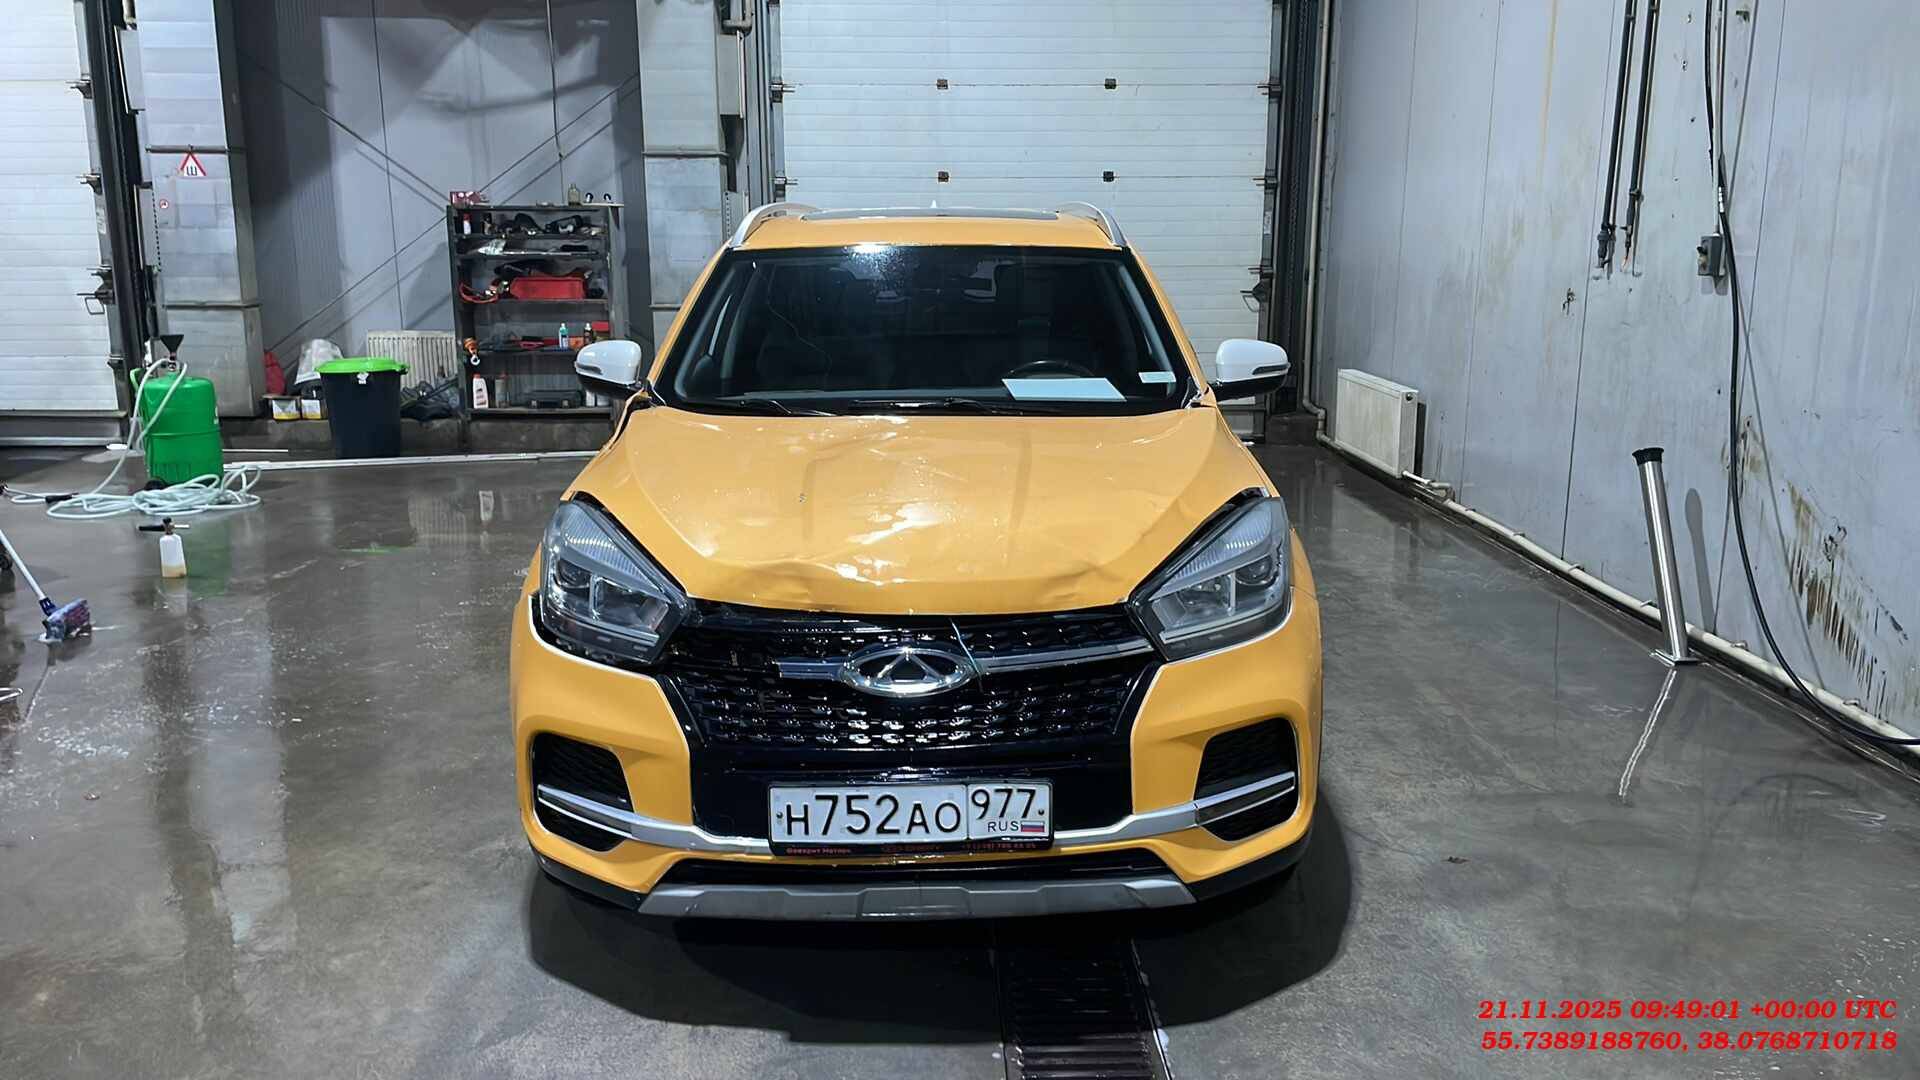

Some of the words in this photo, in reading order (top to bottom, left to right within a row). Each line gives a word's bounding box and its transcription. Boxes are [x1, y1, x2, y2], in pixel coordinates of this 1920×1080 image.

[785, 794, 962, 836] Н752АО
[971, 788, 1037, 820] 977
[987, 821, 1020, 833] RUS
